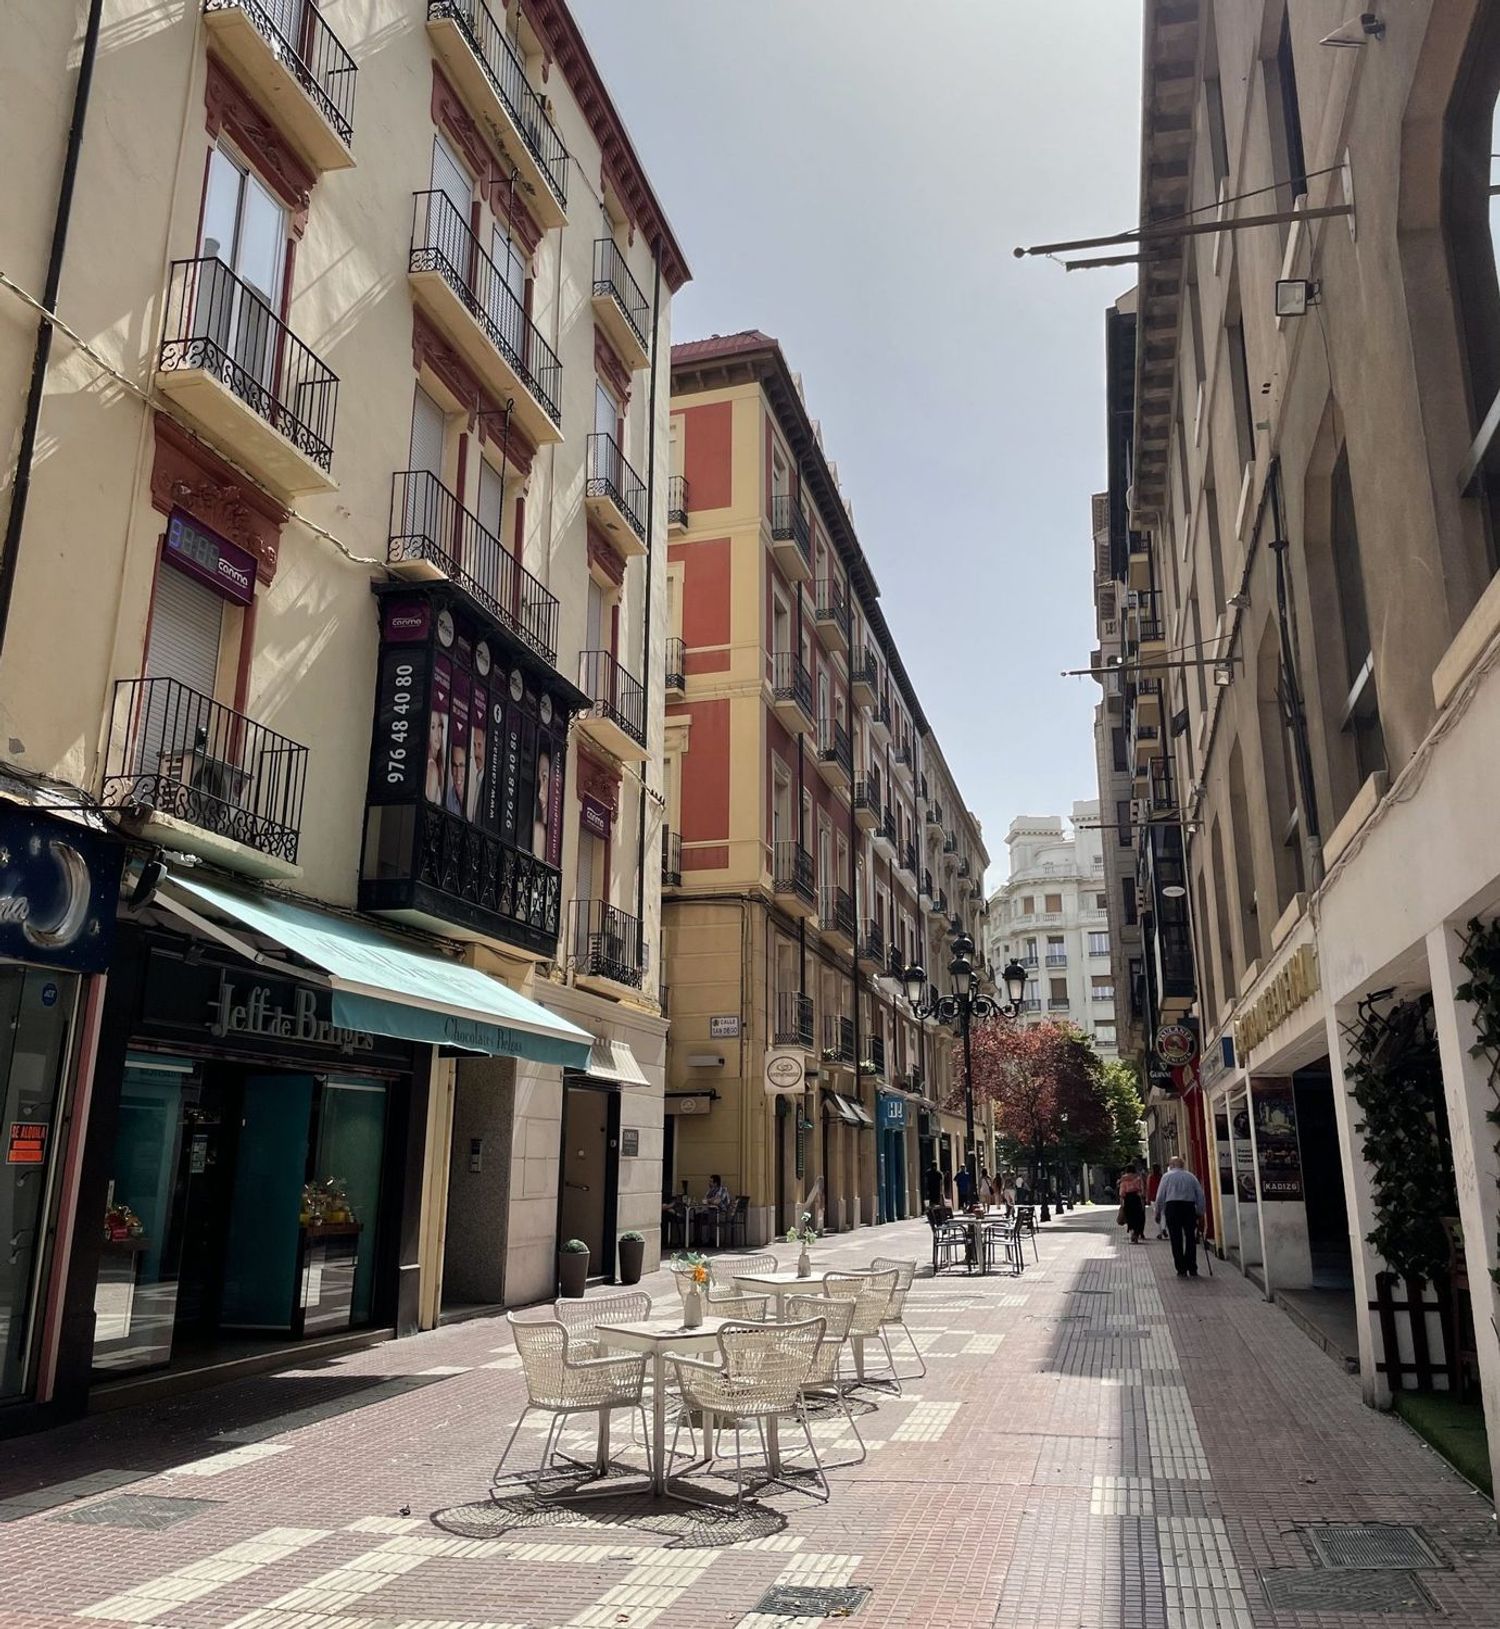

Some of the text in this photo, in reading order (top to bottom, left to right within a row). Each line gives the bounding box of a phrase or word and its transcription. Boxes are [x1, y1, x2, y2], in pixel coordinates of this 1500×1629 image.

[387, 665, 413, 783] 976 48 40 80
[489, 730, 499, 818] www.canma.es
[505, 732, 518, 830] 976 48 40 80
[205, 980, 271, 1038] Jeff
[271, 1006, 292, 1038] de
[1149, 1070, 1172, 1079] GUINN
[12, 1125, 46, 1140] SE ALQUILA
